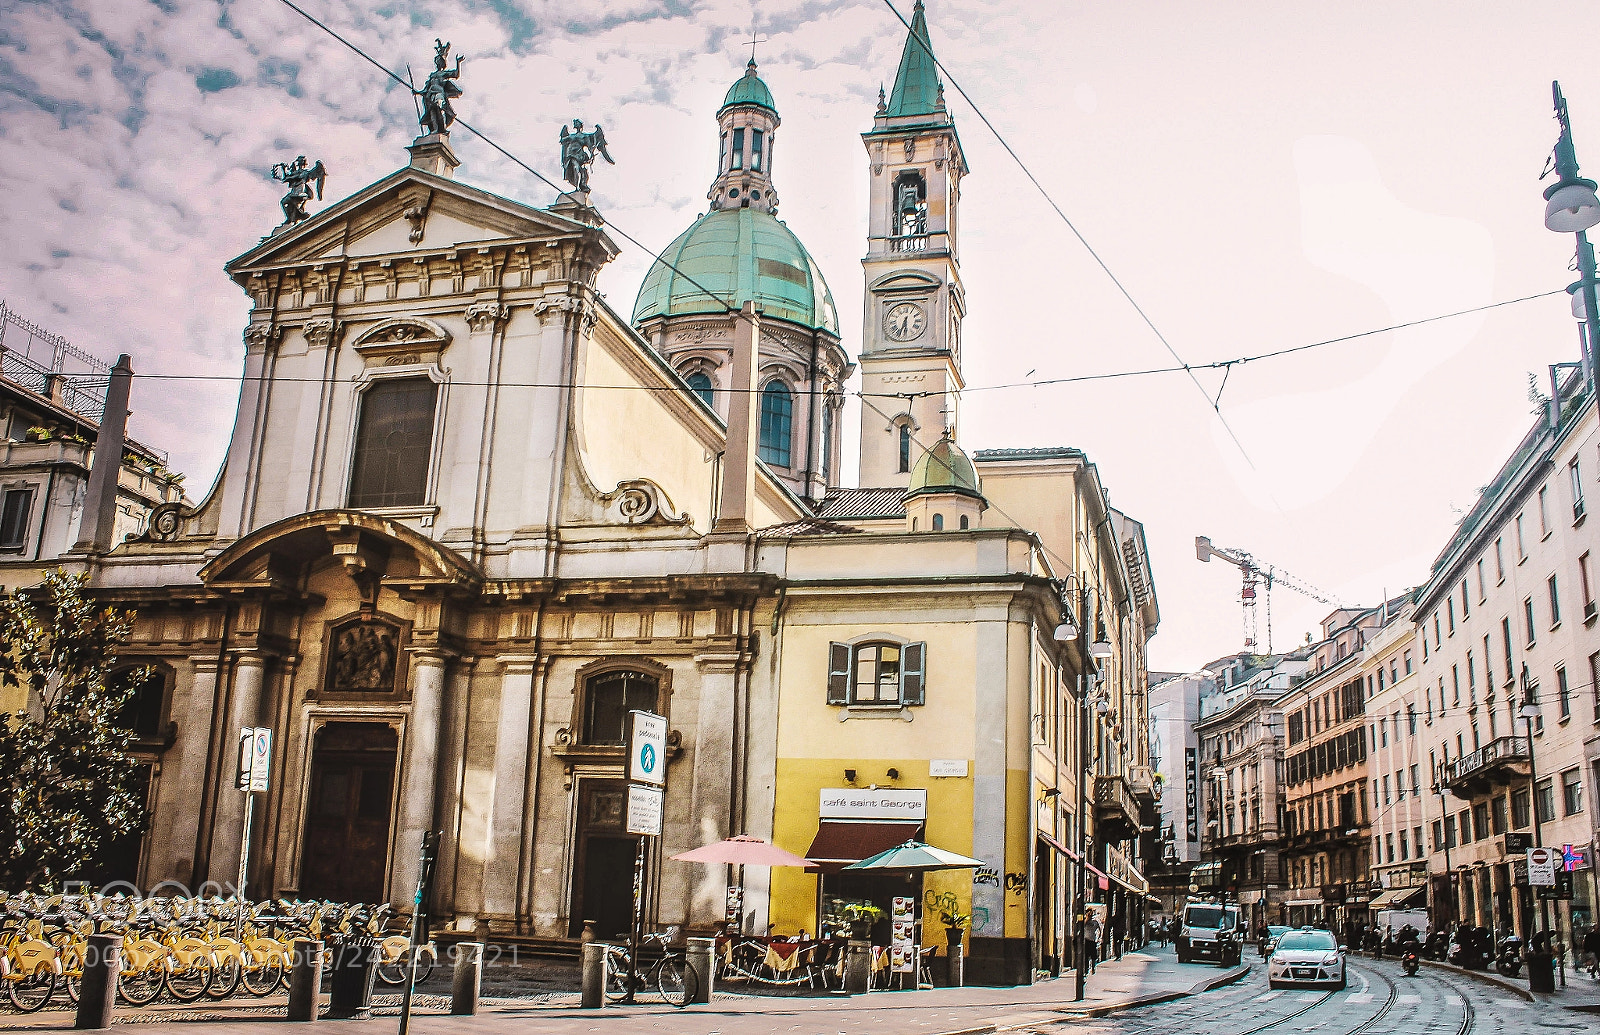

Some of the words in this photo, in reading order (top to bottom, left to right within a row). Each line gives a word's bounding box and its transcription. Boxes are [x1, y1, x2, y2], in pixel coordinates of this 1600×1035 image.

[823, 797, 847, 808] café
[850, 798, 877, 808] saint
[880, 799, 922, 810] George
[1186, 752, 1196, 837] ALCOTT
